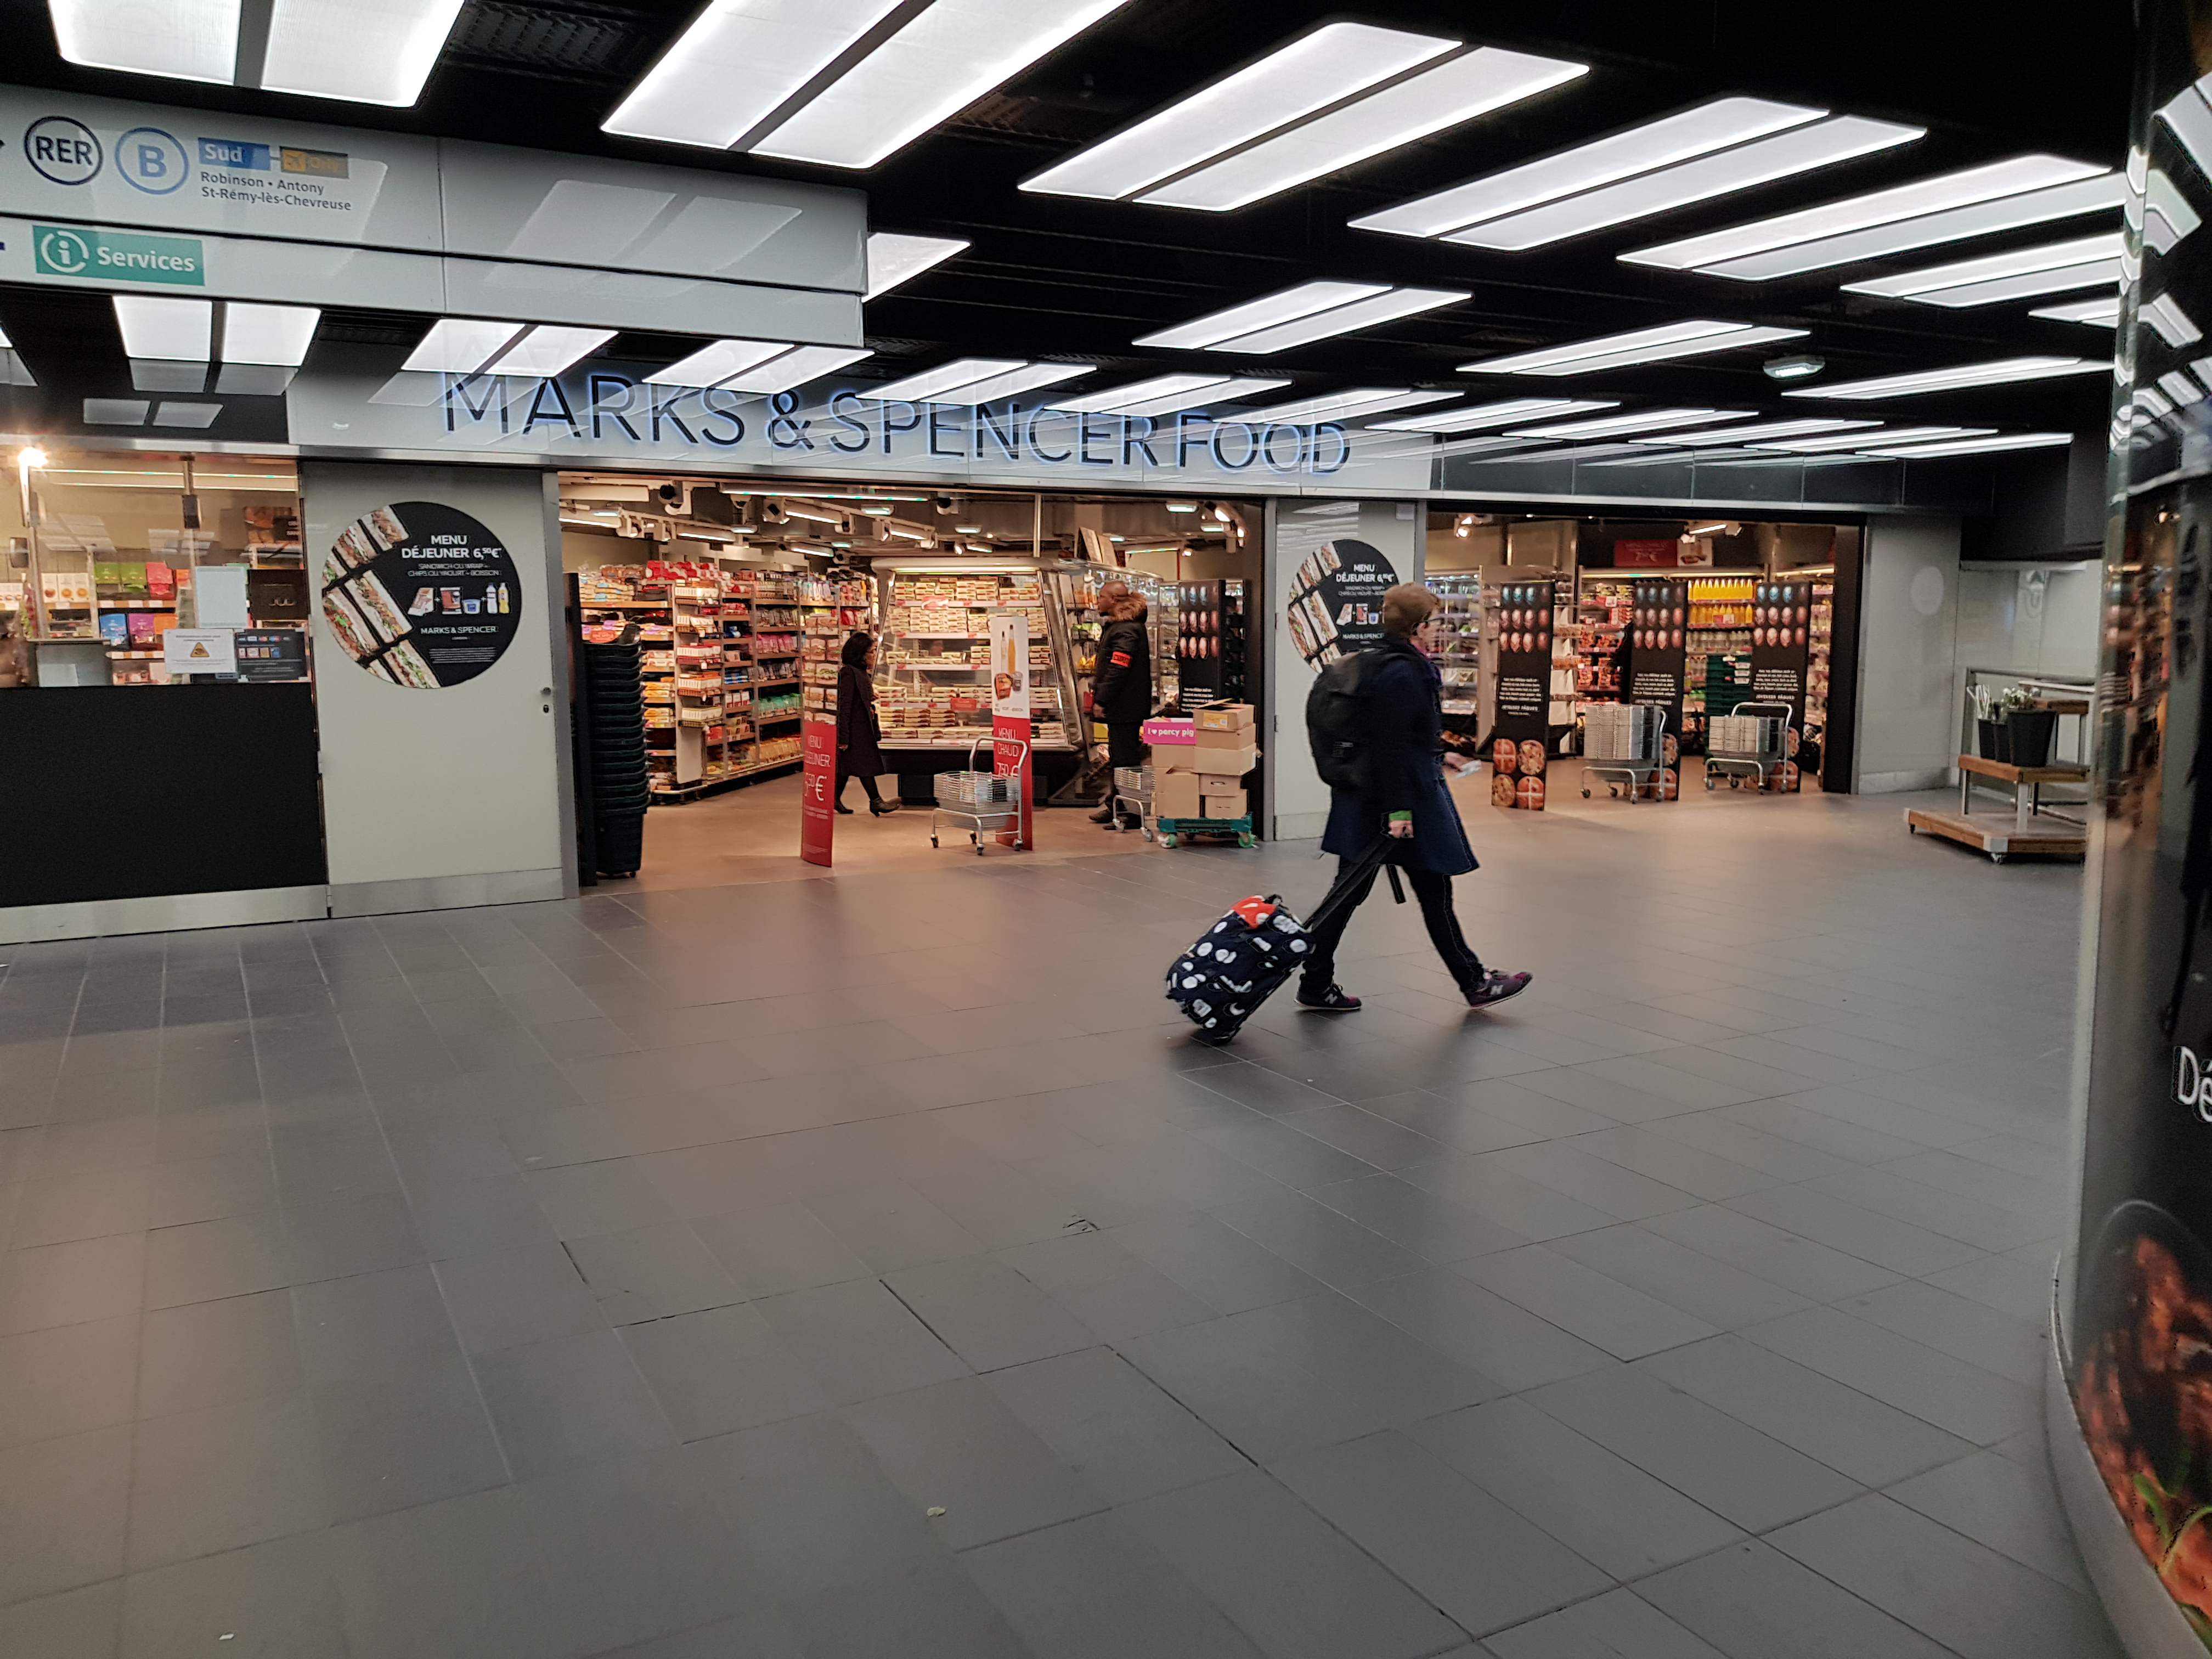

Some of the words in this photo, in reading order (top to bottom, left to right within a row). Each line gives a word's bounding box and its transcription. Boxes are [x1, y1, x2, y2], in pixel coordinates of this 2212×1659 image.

[36, 136, 94, 166] RER
[138, 144, 167, 177] B
[204, 143, 244, 163] Sud
[200, 171, 264, 188] Robinson
[276, 179, 325, 196] Antony
[201, 187, 352, 211] St-Rémy-lès-Chevreuse
[97, 246, 196, 272] Services
[444, 371, 745, 445] MARKS
[768, 390, 814, 450] &
[830, 392, 1159, 467] SPENCER
[1178, 414, 1350, 474] FOOD
[431, 535, 467, 545] MENU
[402, 545, 470, 558] DÉJEUNER
[1353, 564, 1375, 572] MENU
[1336, 572, 1376, 583] DÉJEUNER
[998, 727, 1016, 740] MENU
[1182, 727, 1194, 737] pig
[997, 743, 1019, 757] CHAUD
